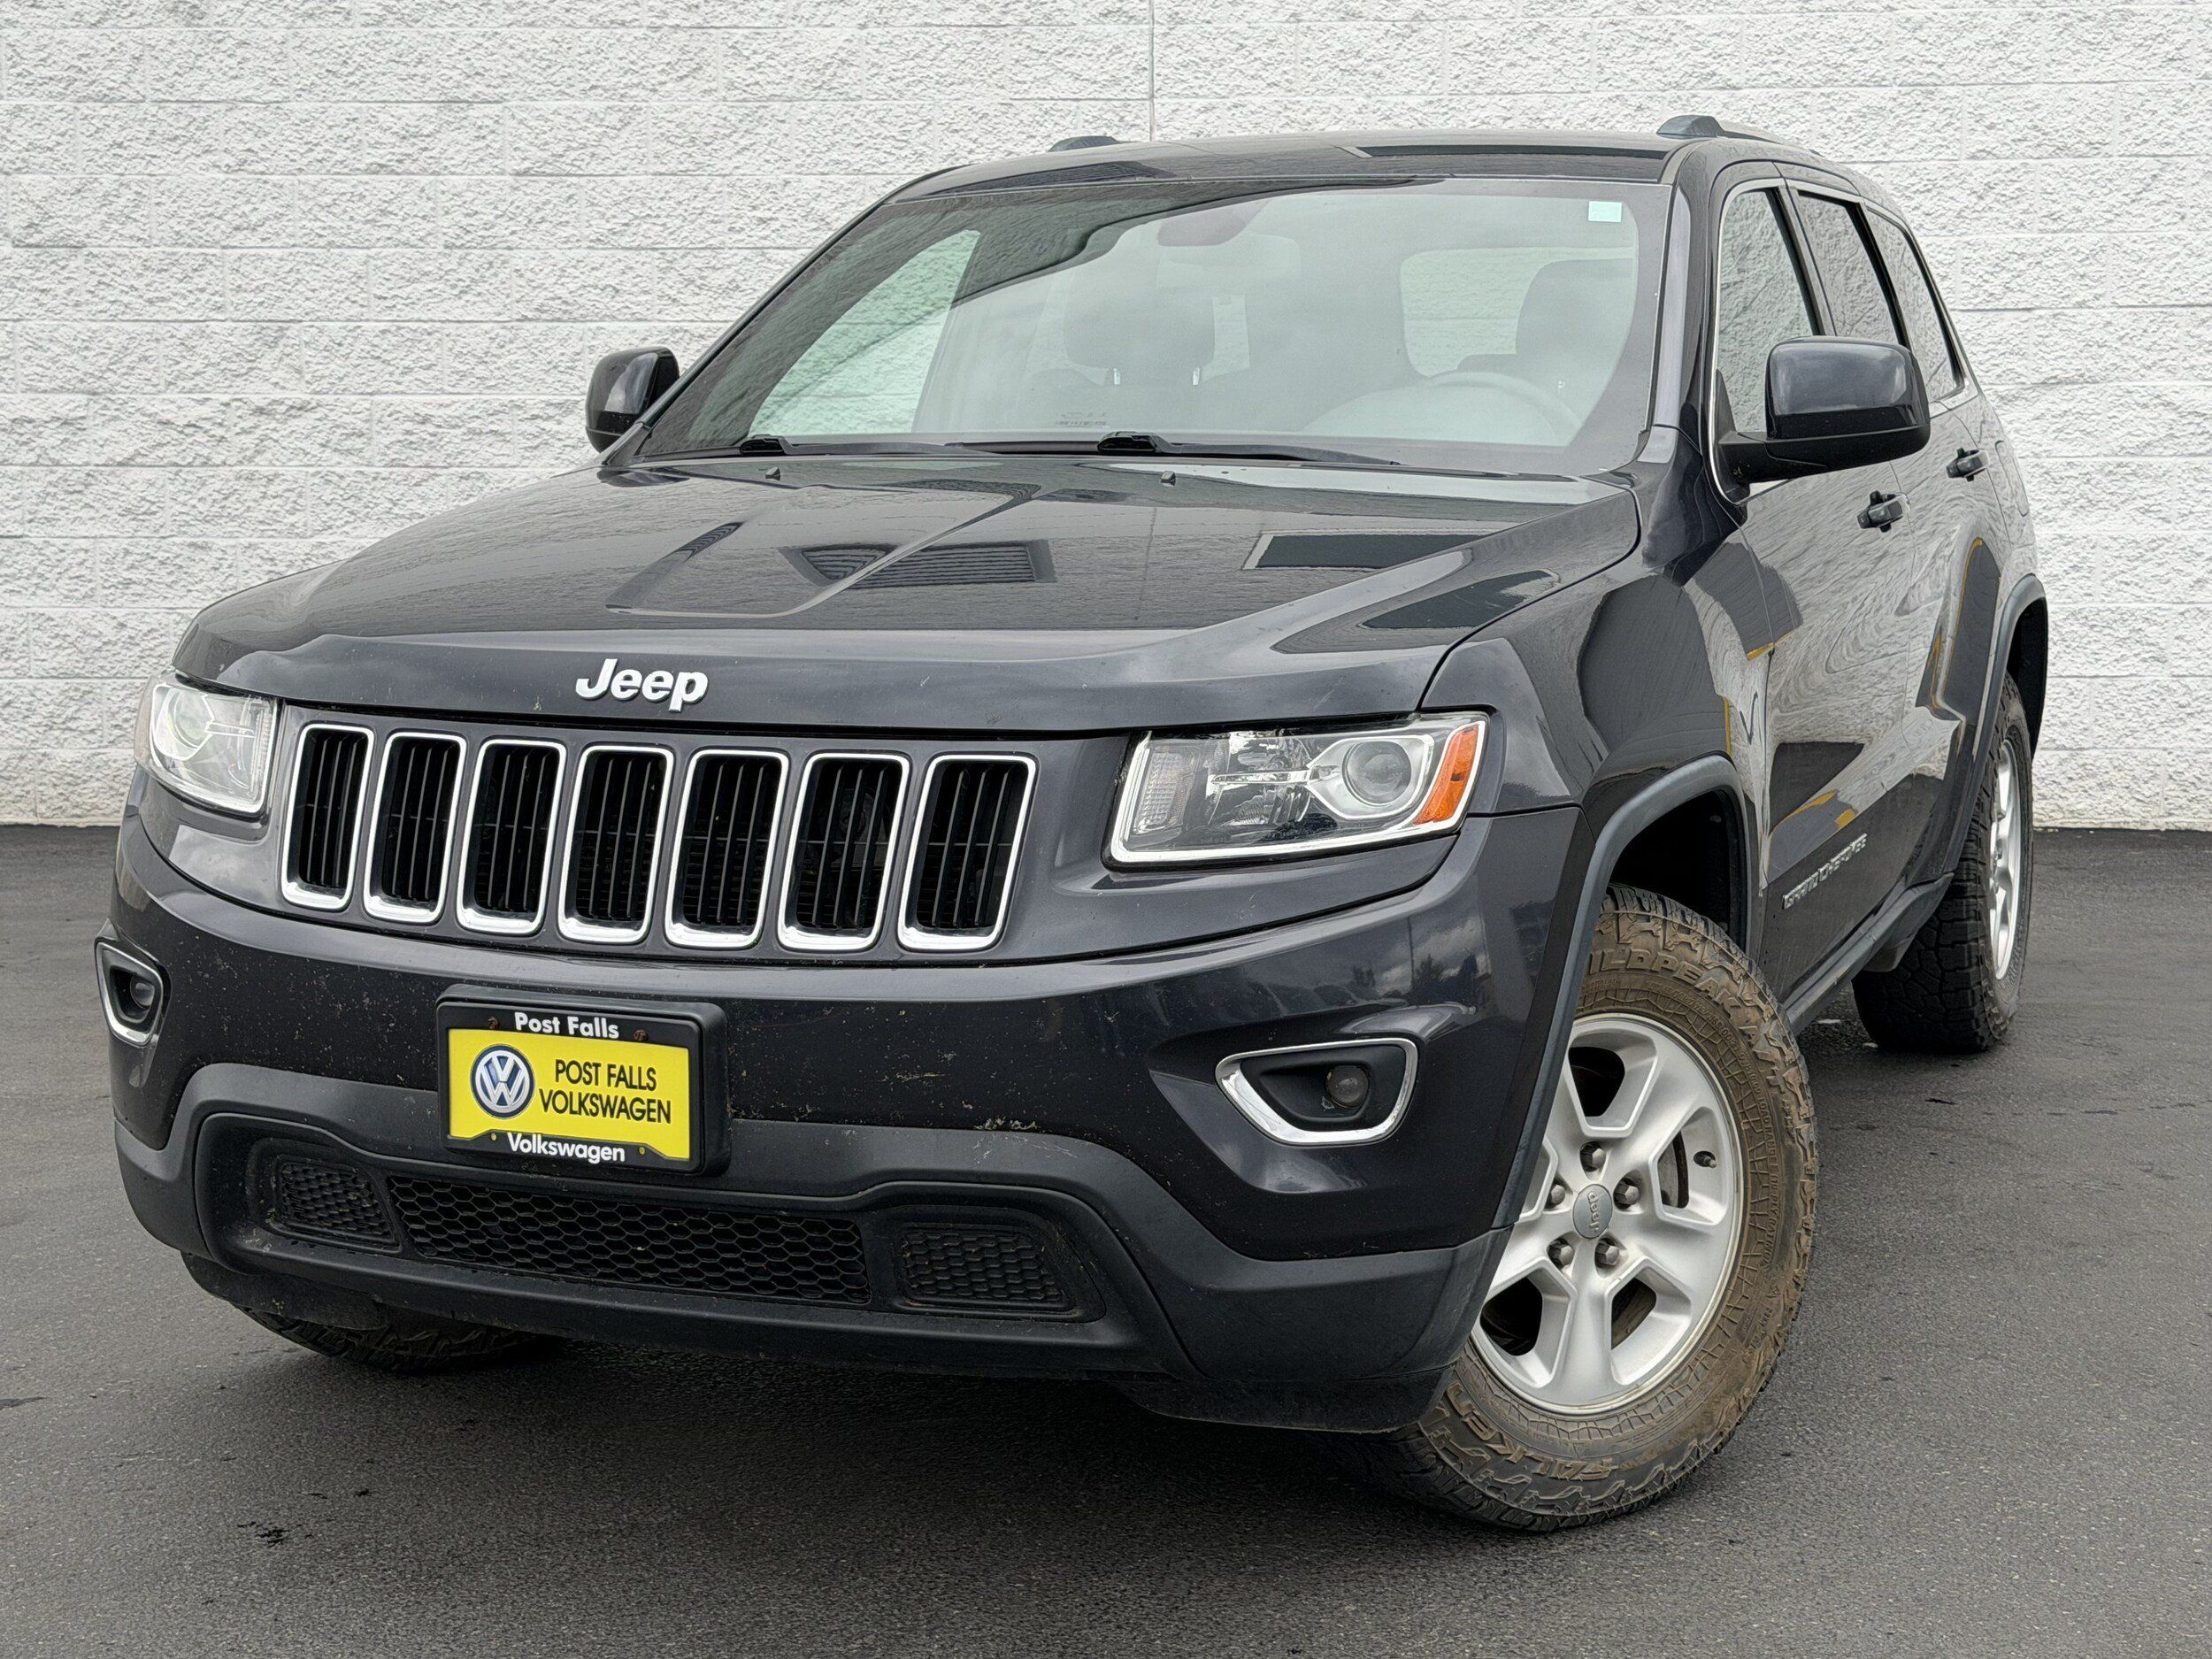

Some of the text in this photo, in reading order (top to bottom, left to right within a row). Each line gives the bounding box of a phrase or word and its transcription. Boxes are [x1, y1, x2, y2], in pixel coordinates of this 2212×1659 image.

[575, 658, 709, 713] Jeep
[1589, 948, 1742, 1020] ILDPEAK
[514, 1011, 619, 1039] Post Falls
[555, 1059, 657, 1091] POST FALLS
[539, 1088, 672, 1124] VOLKSWAGEN
[507, 1132, 626, 1164] Volkswagen
